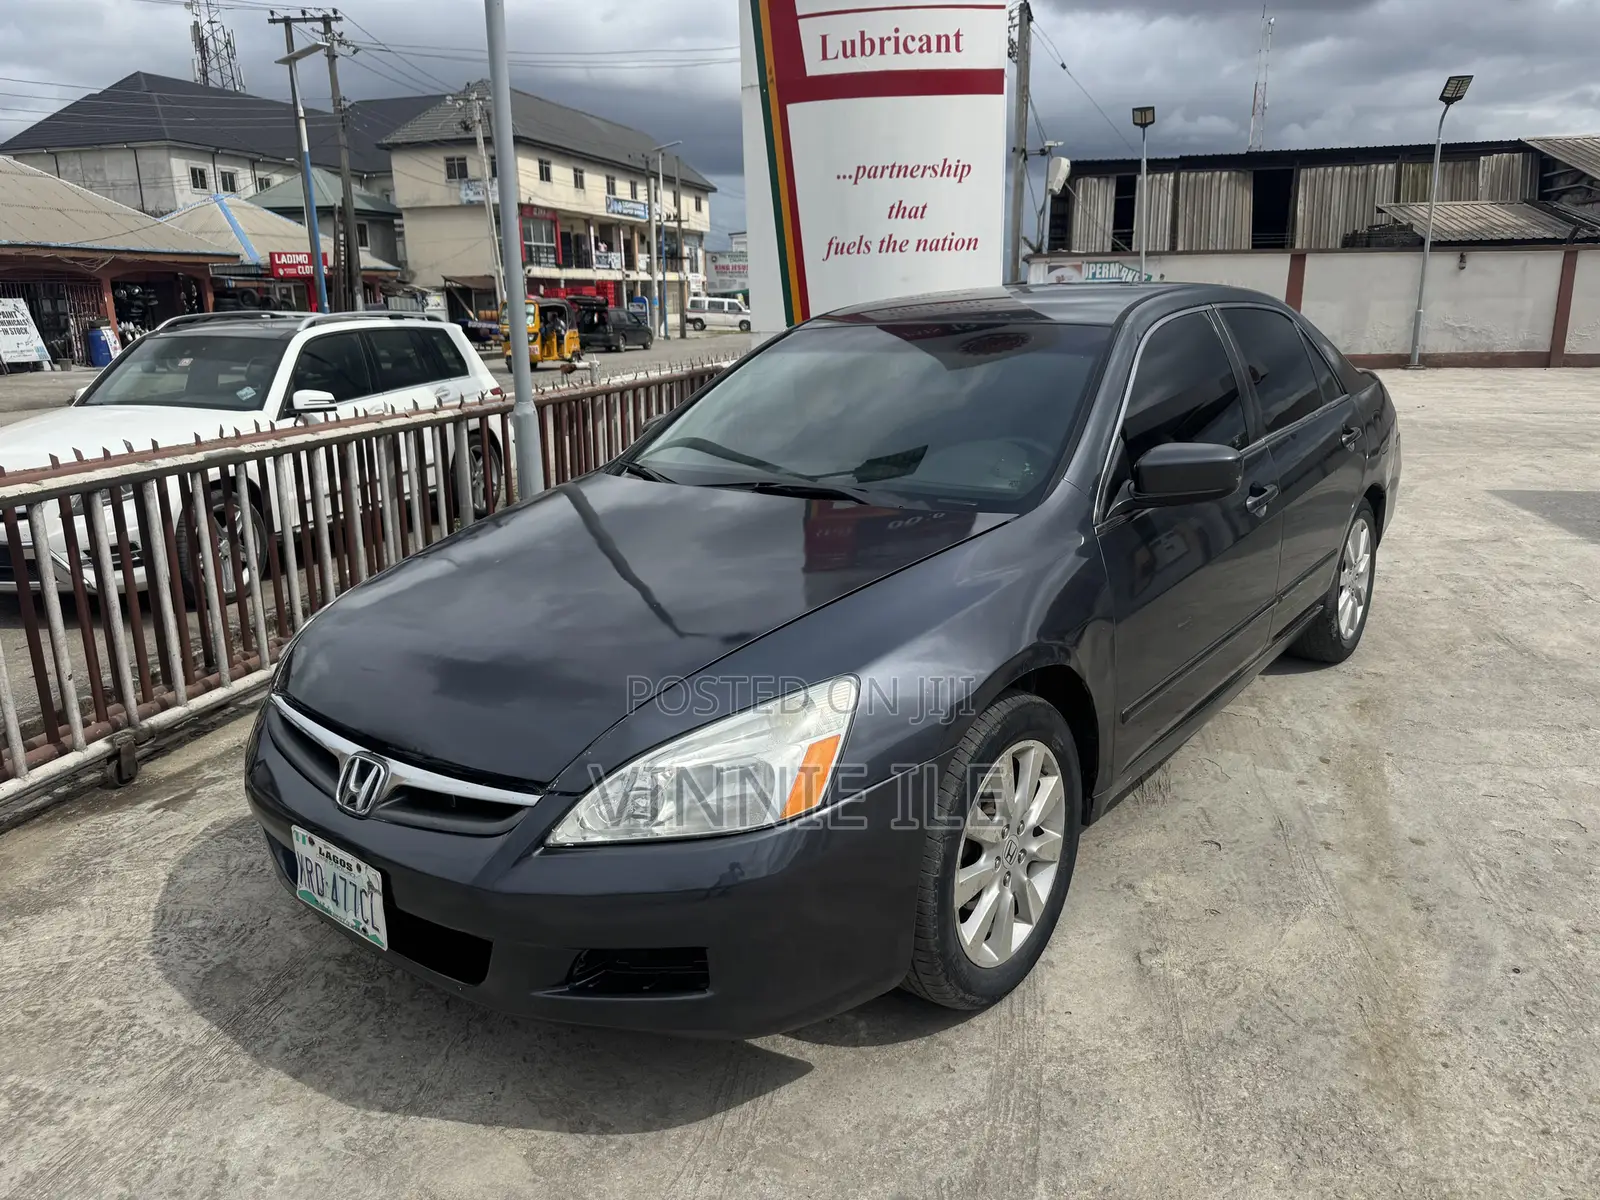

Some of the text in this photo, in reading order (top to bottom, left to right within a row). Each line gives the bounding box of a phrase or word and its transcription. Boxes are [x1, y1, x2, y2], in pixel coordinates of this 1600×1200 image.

[819, 27, 964, 61] Lubricant
[836, 158, 972, 185] ...partnership
[887, 200, 928, 219] that
[822, 232, 979, 261] fuels the nation
[275, 254, 309, 264] LADIMO
[297, 265, 329, 275] CLOTG
[10, 327, 29, 335] STOCK
[318, 846, 354, 872] LAGOS
